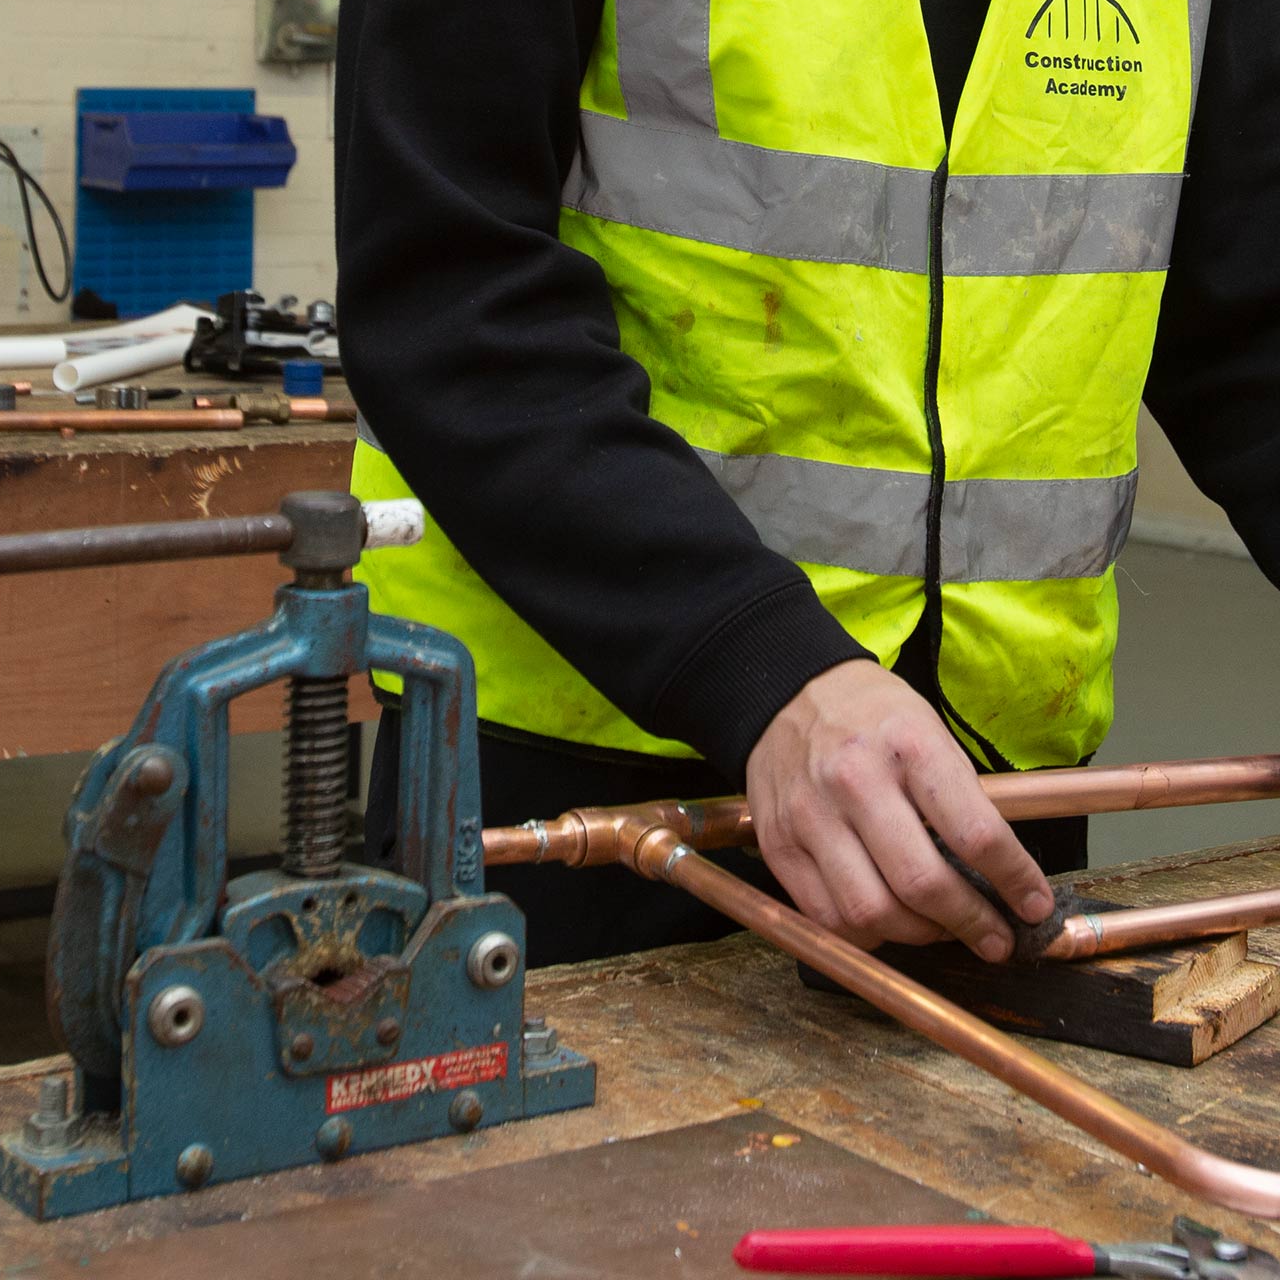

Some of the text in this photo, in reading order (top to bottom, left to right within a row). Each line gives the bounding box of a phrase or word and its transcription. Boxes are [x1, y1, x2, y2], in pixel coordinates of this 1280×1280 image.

[1024, 52, 1144, 73] Construction
[1045, 78, 1128, 101] Academy
[331, 1059, 436, 1098] KENNEDY
